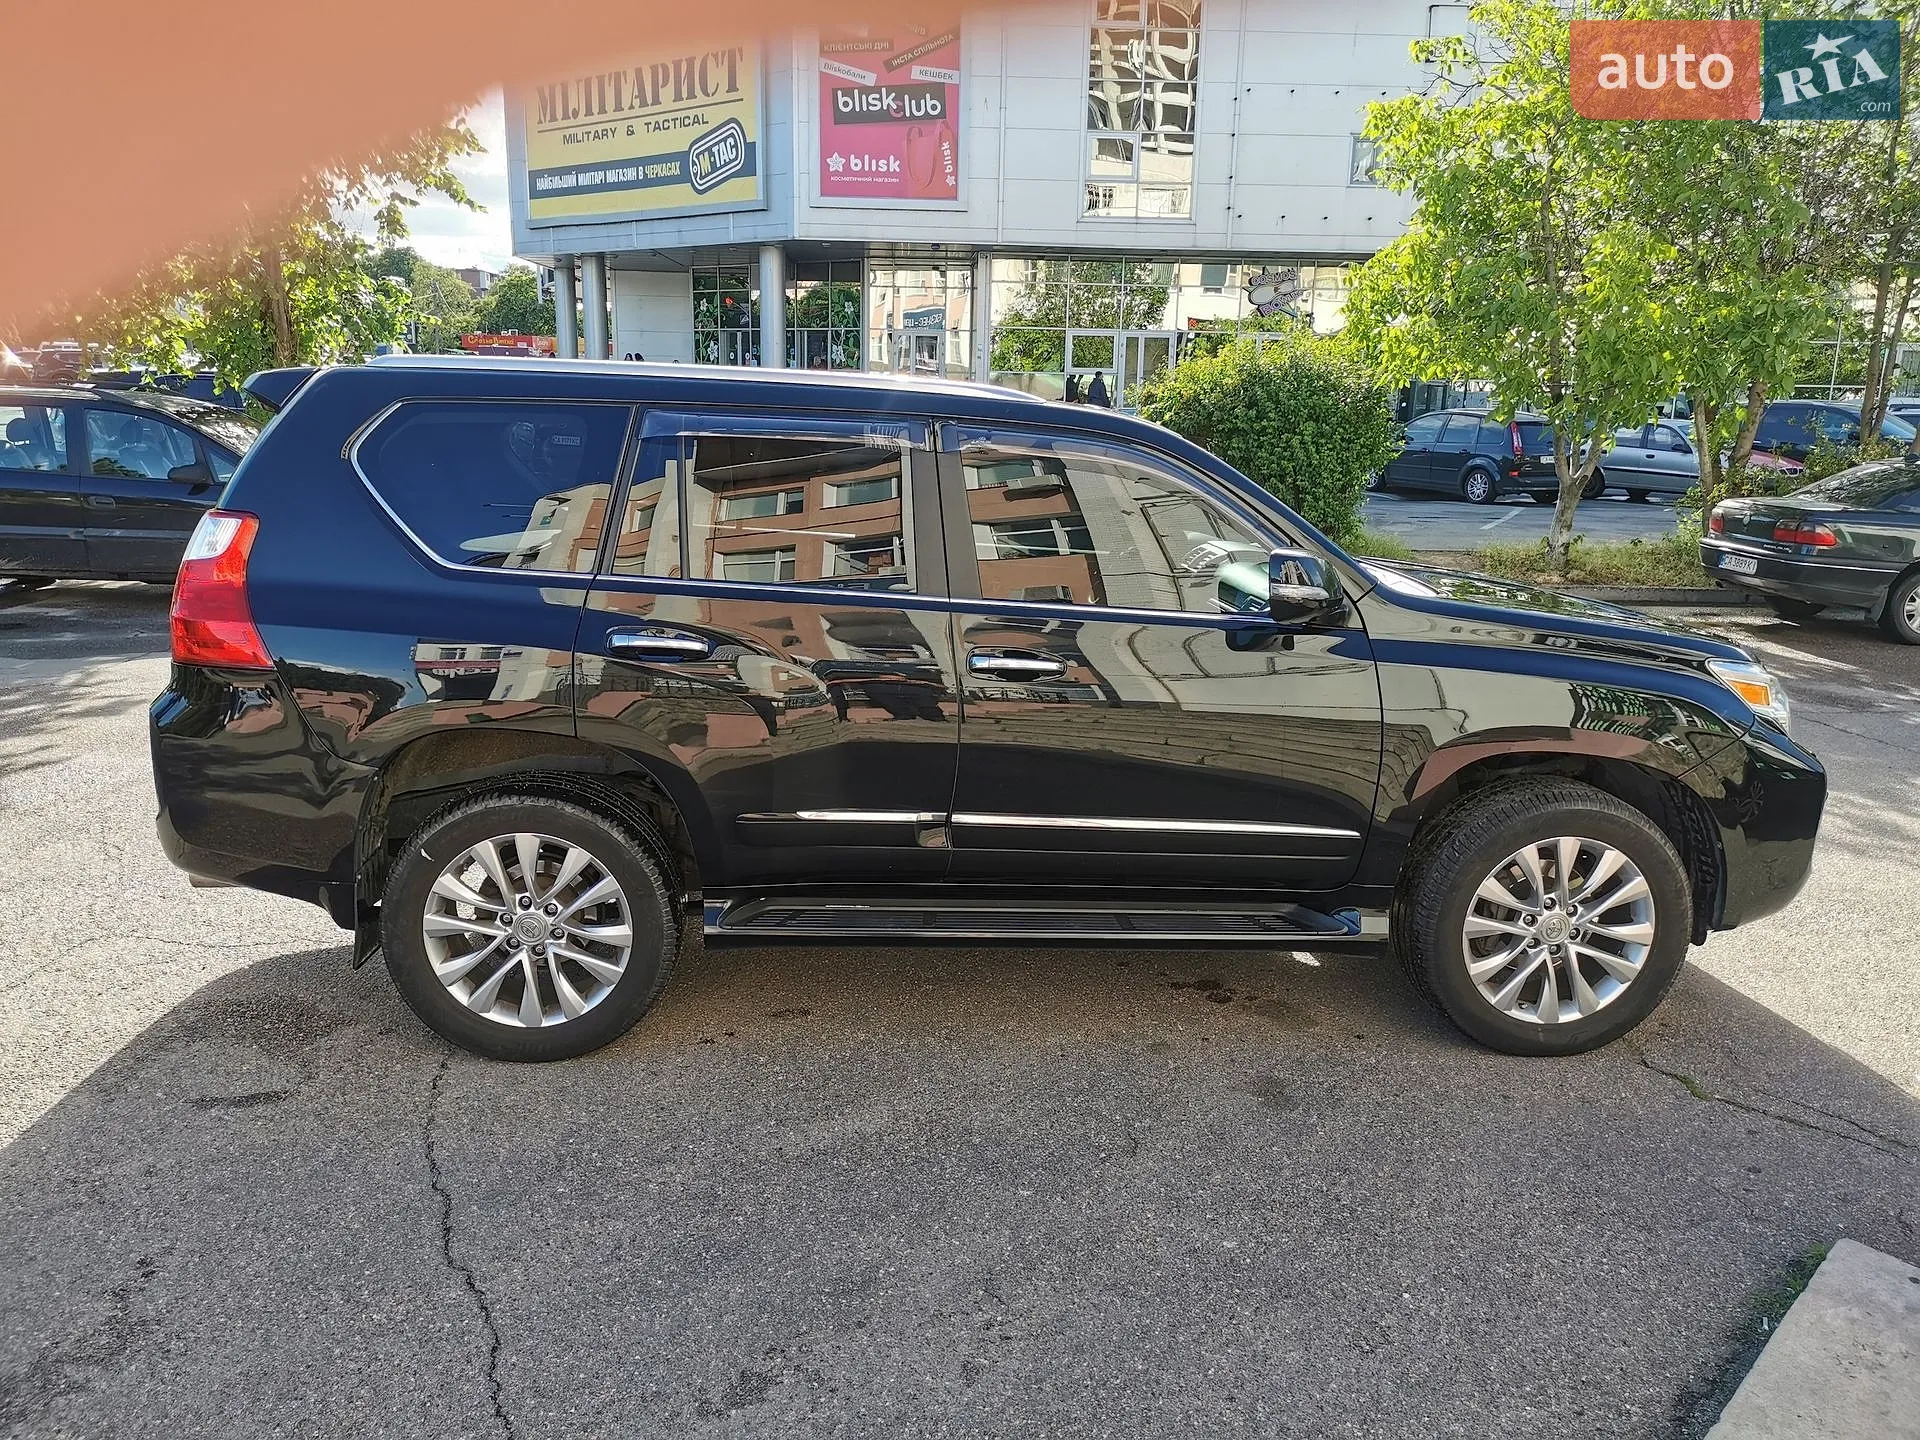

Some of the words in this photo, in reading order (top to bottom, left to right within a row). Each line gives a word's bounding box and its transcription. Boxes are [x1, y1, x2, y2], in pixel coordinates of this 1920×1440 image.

[536, 46, 743, 125] МІЛІТАРИСТ
[919, 68, 954, 81] КЕШБЕК
[563, 127, 617, 145] MILITARY
[626, 125, 636, 136] &
[644, 113, 709, 134] TACTICAL
[849, 153, 901, 173] blisk
[941, 141, 953, 173] blisk
[536, 171, 577, 191] НАЙБІЛЬШИЙ
[578, 171, 605, 186] МІЛІТАРІ
[606, 167, 637, 183] МАГАЗИН
[638, 168, 644, 180] В
[645, 161, 681, 178] ЧЕРКАСАХ
